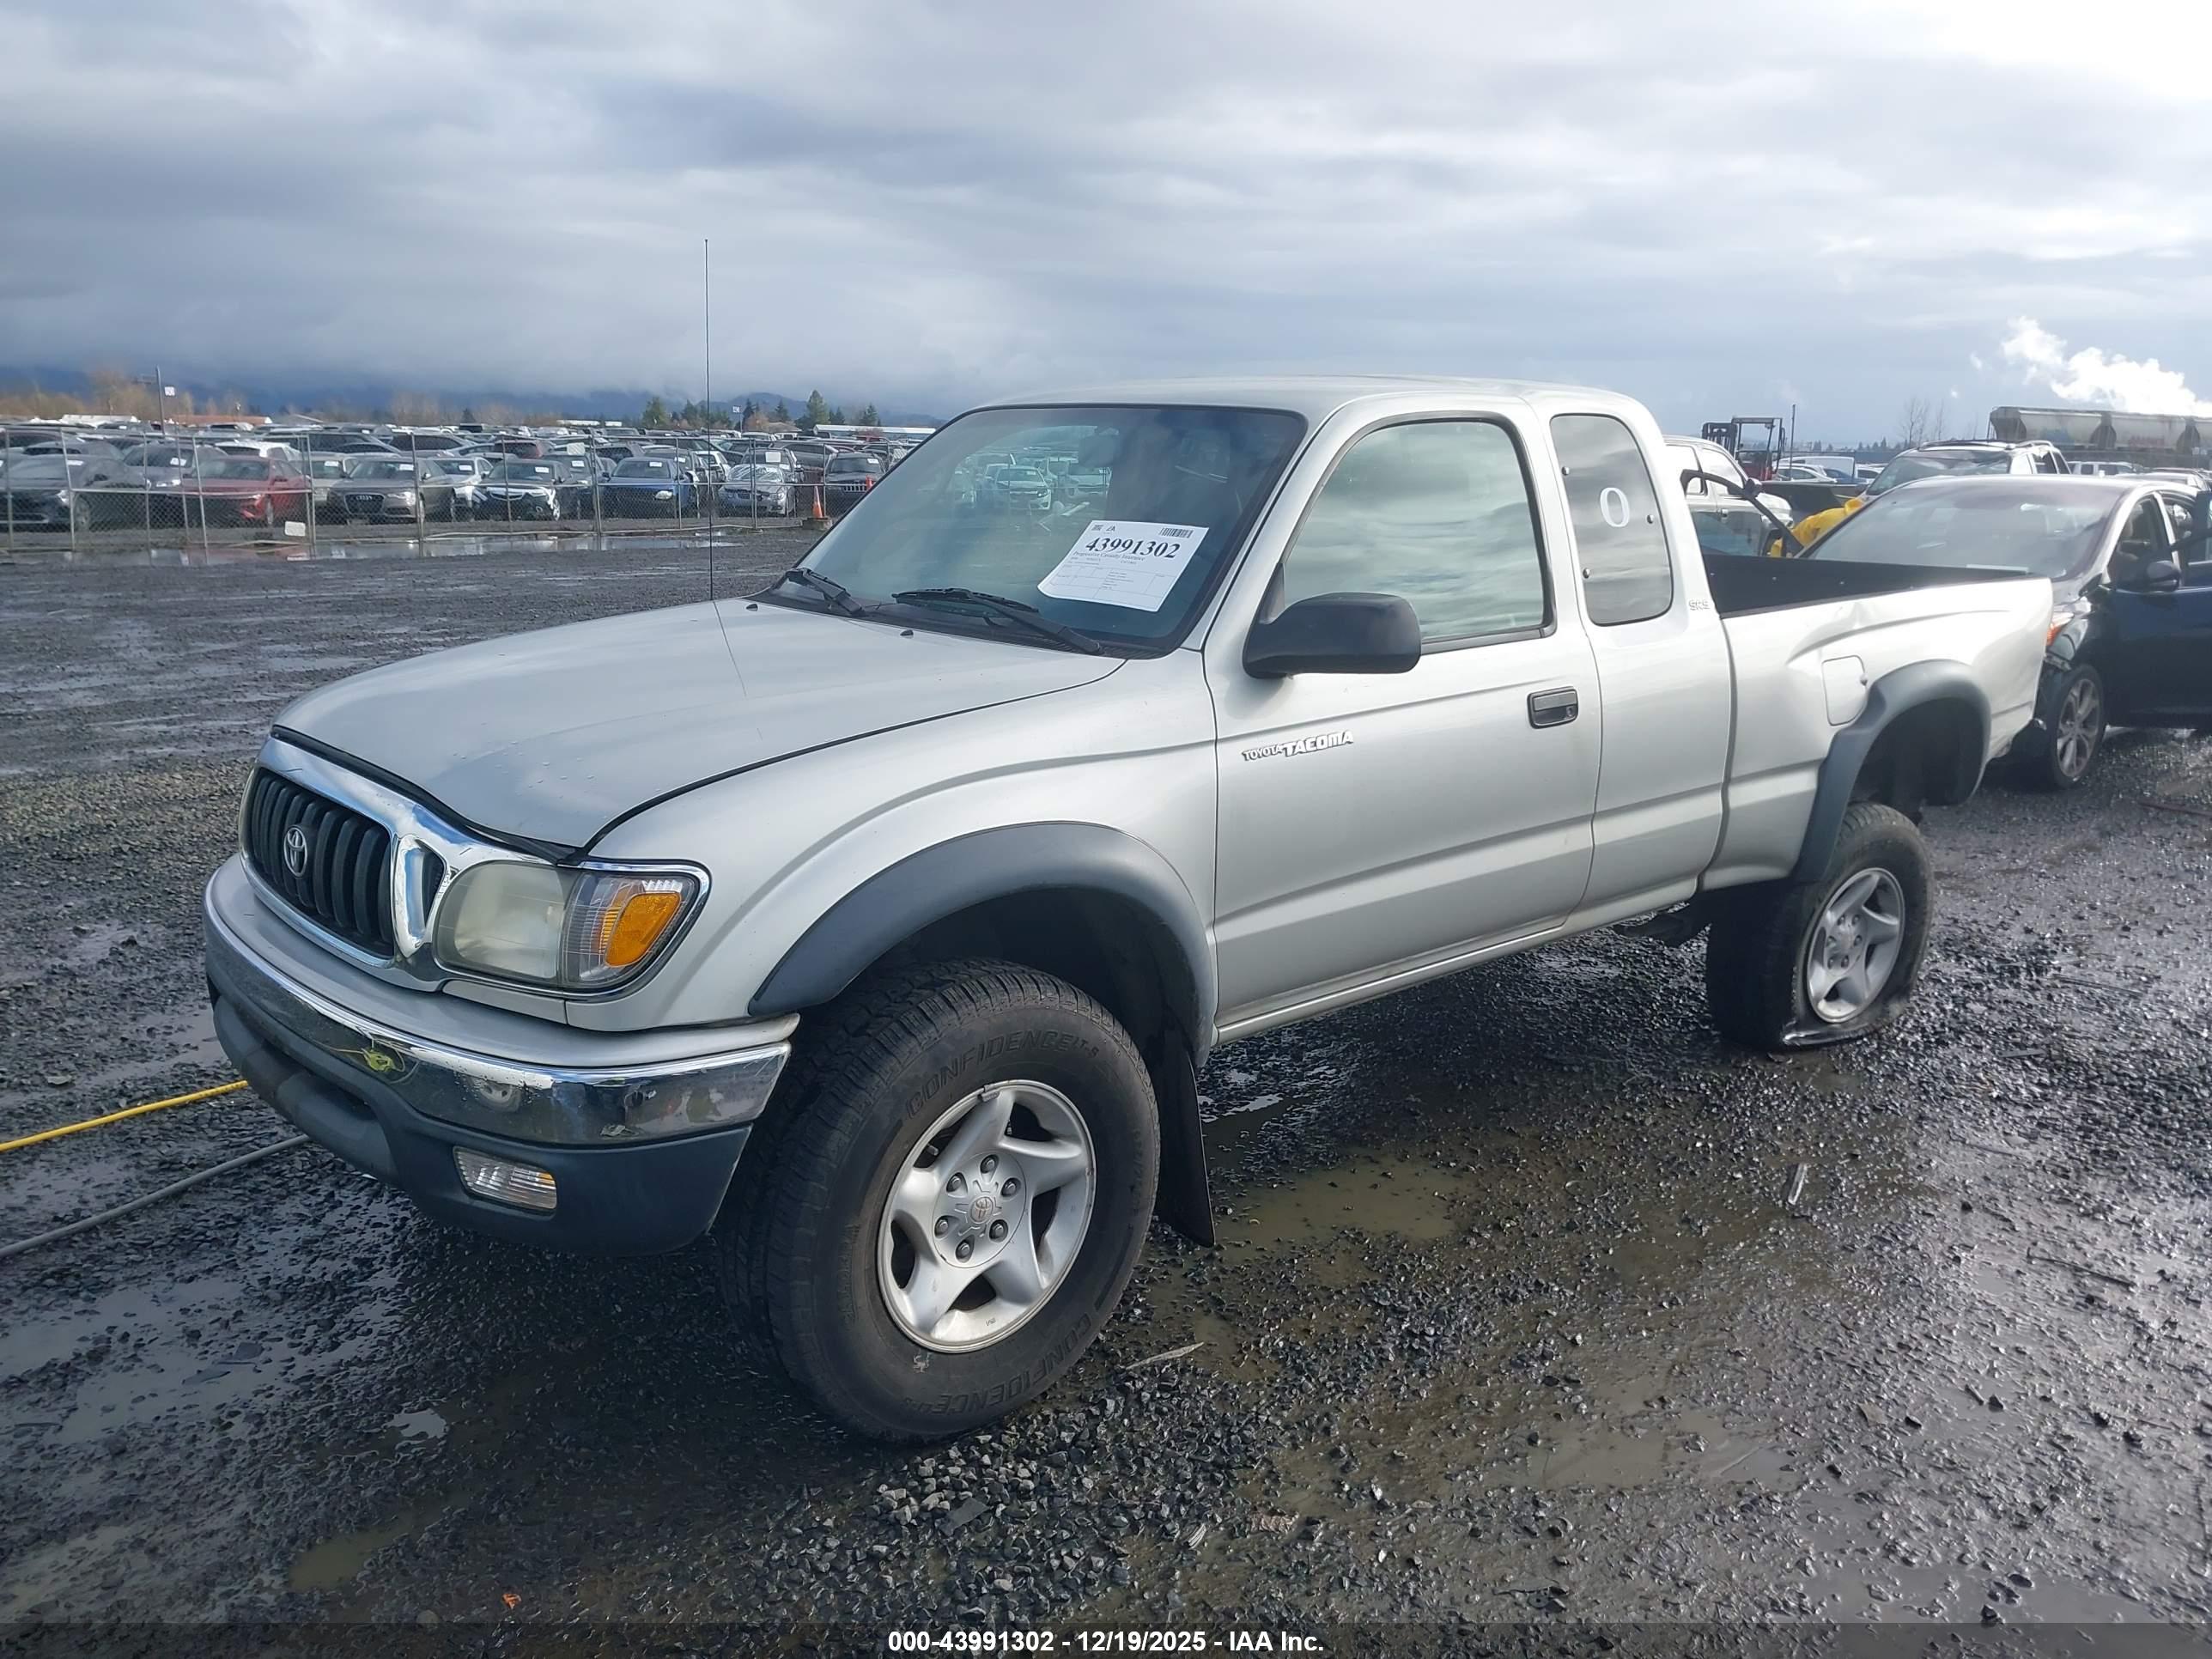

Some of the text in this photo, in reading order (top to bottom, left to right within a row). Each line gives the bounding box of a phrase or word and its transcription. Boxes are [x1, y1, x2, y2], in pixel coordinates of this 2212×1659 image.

[1600, 487, 1630, 527] 0
[1085, 537, 1181, 559] 43991302
[1243, 730, 1354, 761] TOYOTA TACOMA
[907, 1029, 1075, 1119] CONFIDENCE
[932, 1314, 1092, 1416] CONFIDENCE
